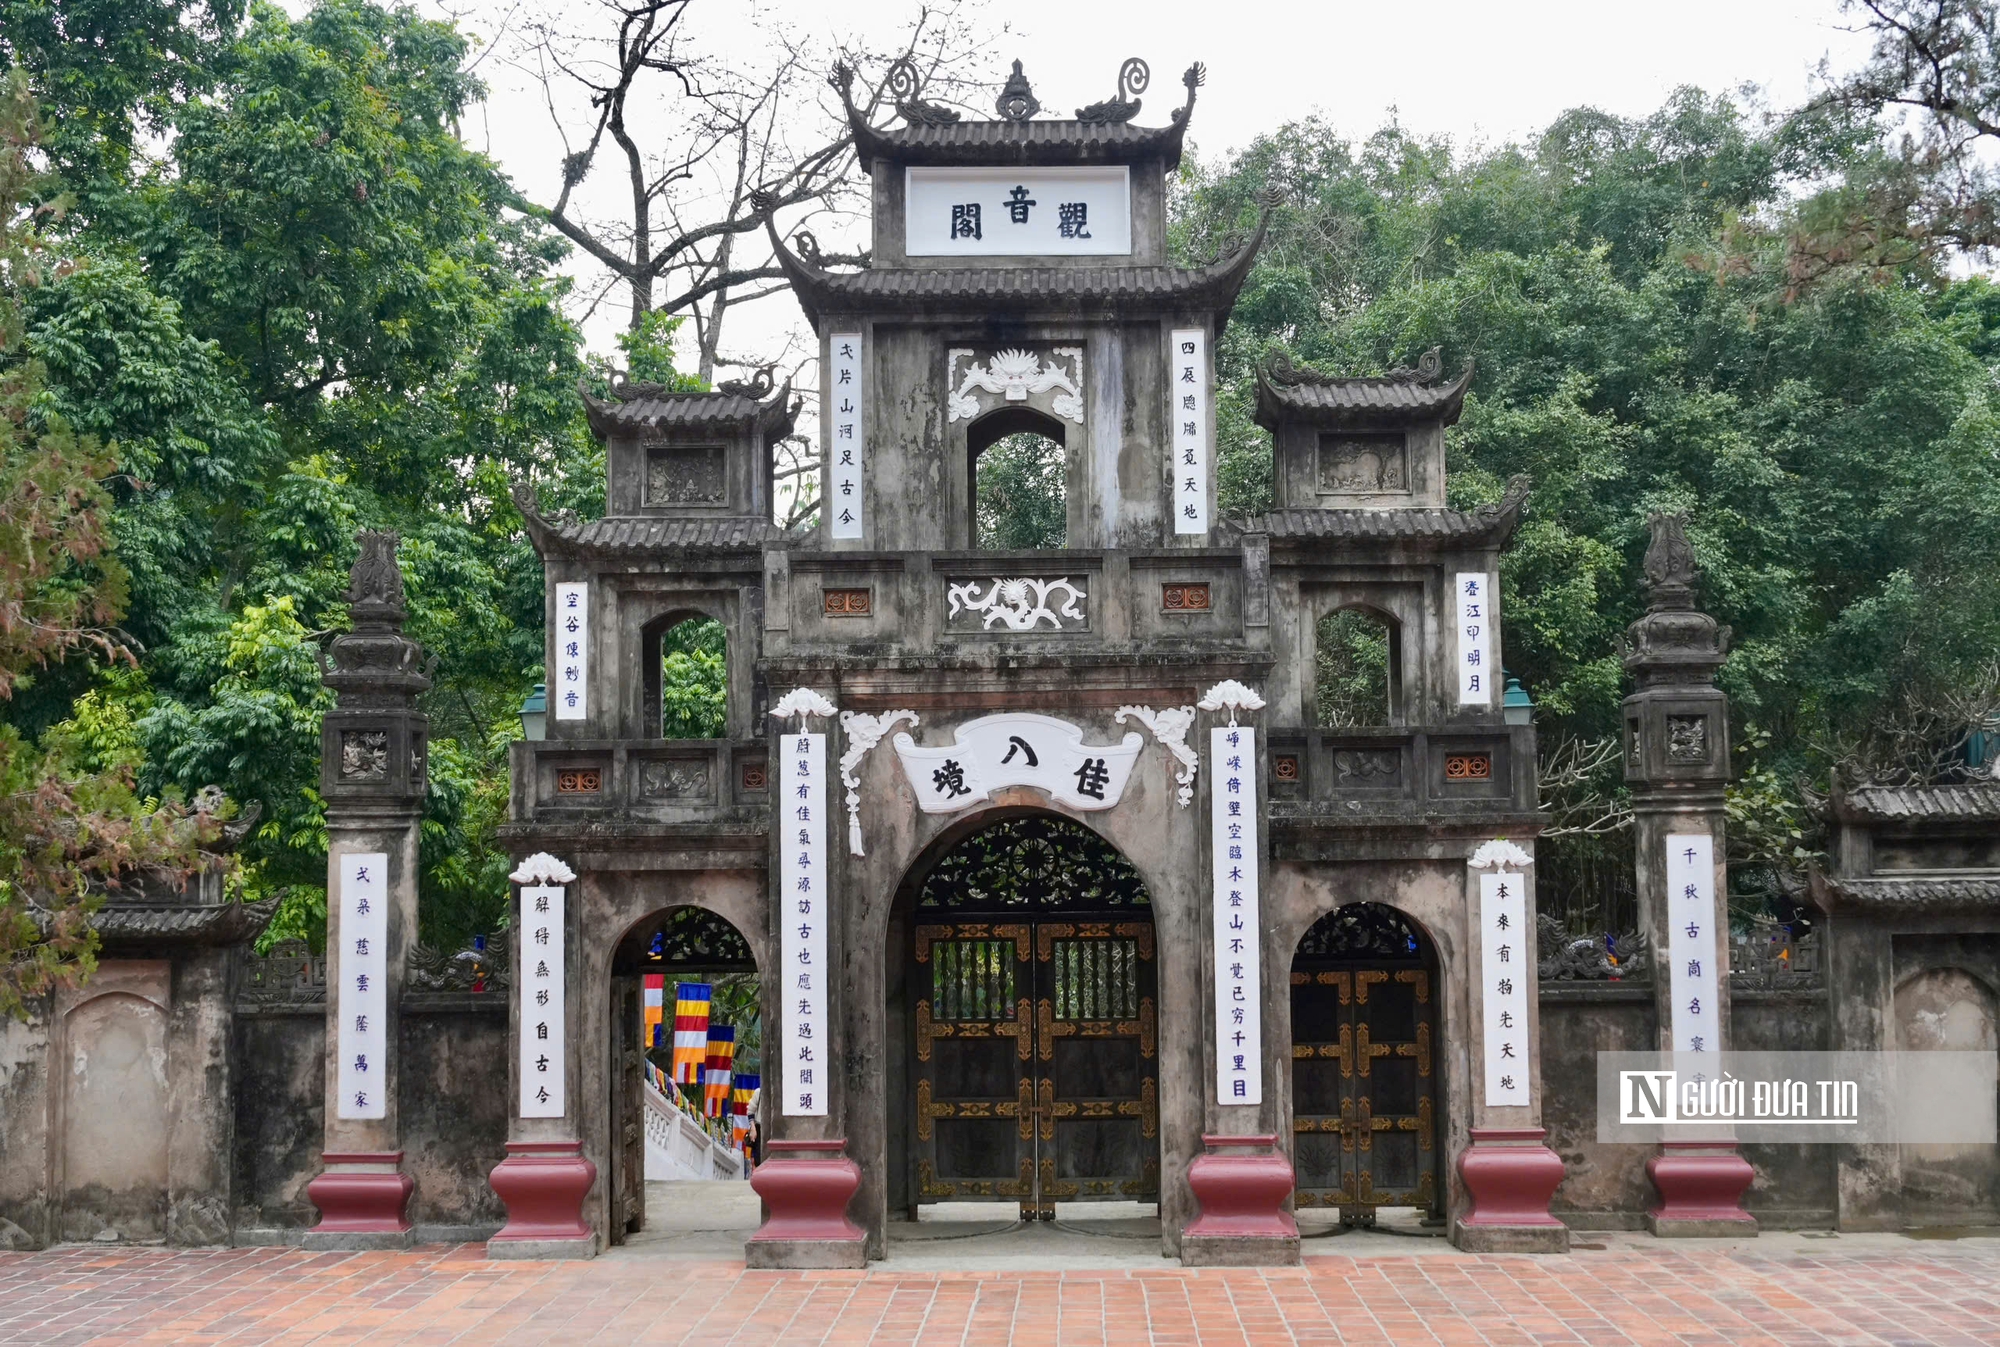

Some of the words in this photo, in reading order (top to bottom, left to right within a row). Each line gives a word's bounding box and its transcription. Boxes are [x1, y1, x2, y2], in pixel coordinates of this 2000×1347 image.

[951, 185, 1092, 240] 觀音閣
[1496, 882, 1516, 1090] 本來有物先天地
